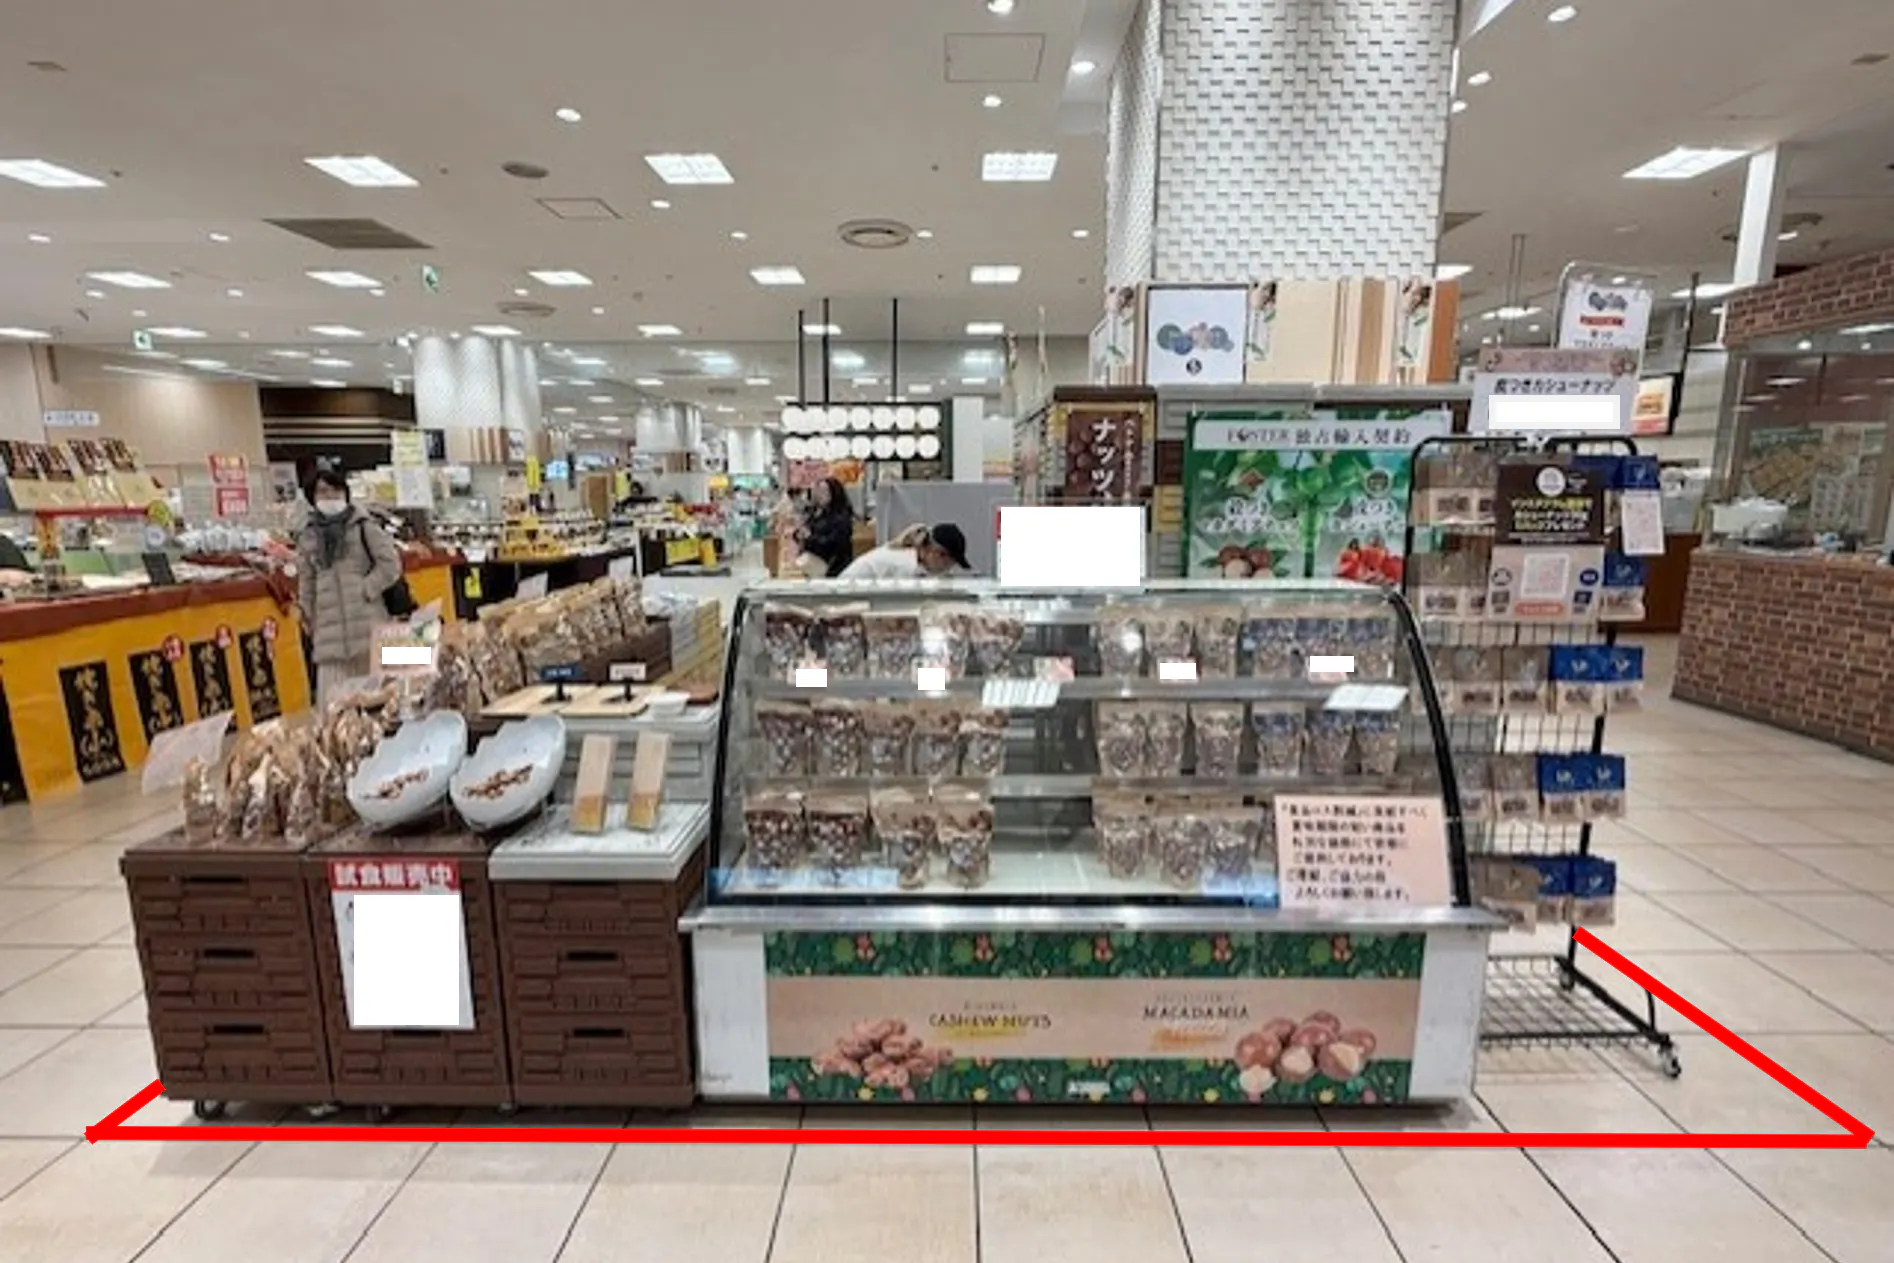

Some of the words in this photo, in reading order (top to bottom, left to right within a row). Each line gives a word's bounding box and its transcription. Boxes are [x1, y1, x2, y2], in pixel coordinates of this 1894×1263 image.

[334, 863, 453, 887] 試食販売中
[1143, 1005, 1250, 1020] MACADAMIA
[929, 1013, 997, 1028] CASHEW
[1002, 1013, 1053, 1029] NUTS
